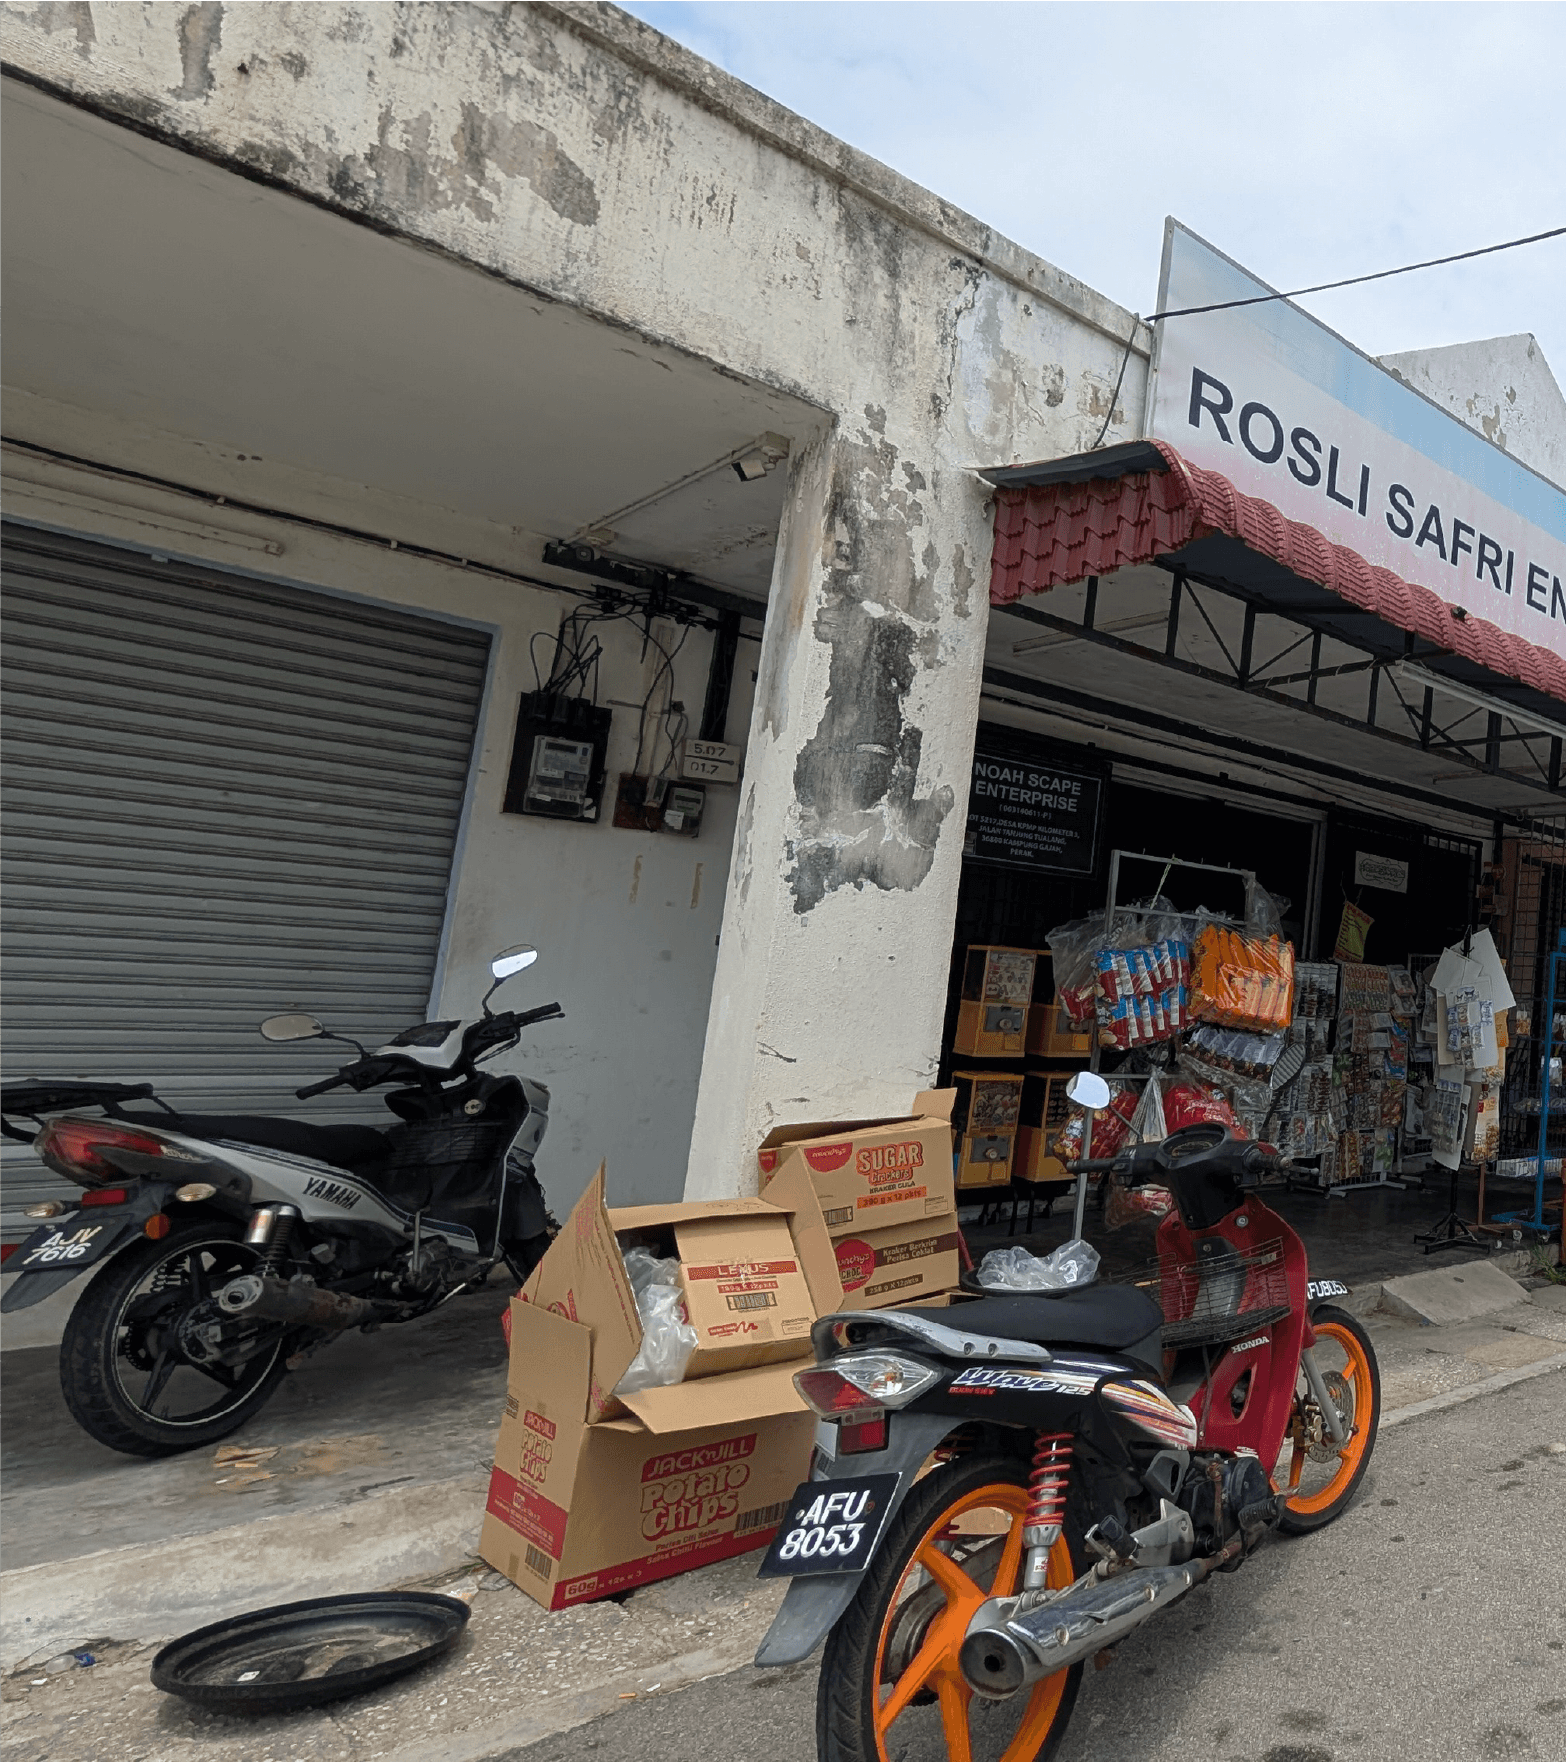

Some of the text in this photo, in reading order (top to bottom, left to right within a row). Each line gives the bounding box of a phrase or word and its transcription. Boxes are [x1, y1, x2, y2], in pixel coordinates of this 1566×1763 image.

[1188, 366, 1370, 518] ROSLI
[1384, 482, 1515, 596] SAFRI
[974, 762, 1082, 796] NOAH SCAPE
[974, 780, 1078, 812] ENTERPRISE
[978, 825, 1002, 836] JALAN
[1002, 828, 1034, 841] TANJUNG
[1003, 838, 1039, 850] KAMPUNG
[858, 1143, 921, 1172] SUGAR
[869, 1180, 916, 1194] KRAKER GULA
[870, 1168, 911, 1183] Crackers
[302, 1176, 364, 1211] YAMAHA
[43, 1225, 104, 1248] AJV
[22, 1242, 92, 1266] 7616
[838, 1253, 870, 1267] unchy's
[882, 1246, 908, 1258] Kraker
[886, 1246, 935, 1264] Perisa Coklat
[717, 1262, 769, 1277] LEXUS
[1231, 1336, 1270, 1354] HONDA
[951, 1366, 1060, 1392] Wave
[1055, 1384, 1095, 1396] 125
[641, 1463, 750, 1513] Potato
[642, 1491, 739, 1541] Chips
[801, 1489, 871, 1526] AFU
[646, 1551, 672, 1566] Salsa
[695, 1536, 724, 1551] Flavour
[779, 1522, 866, 1560] 8053
[568, 1578, 596, 1597] 60g
